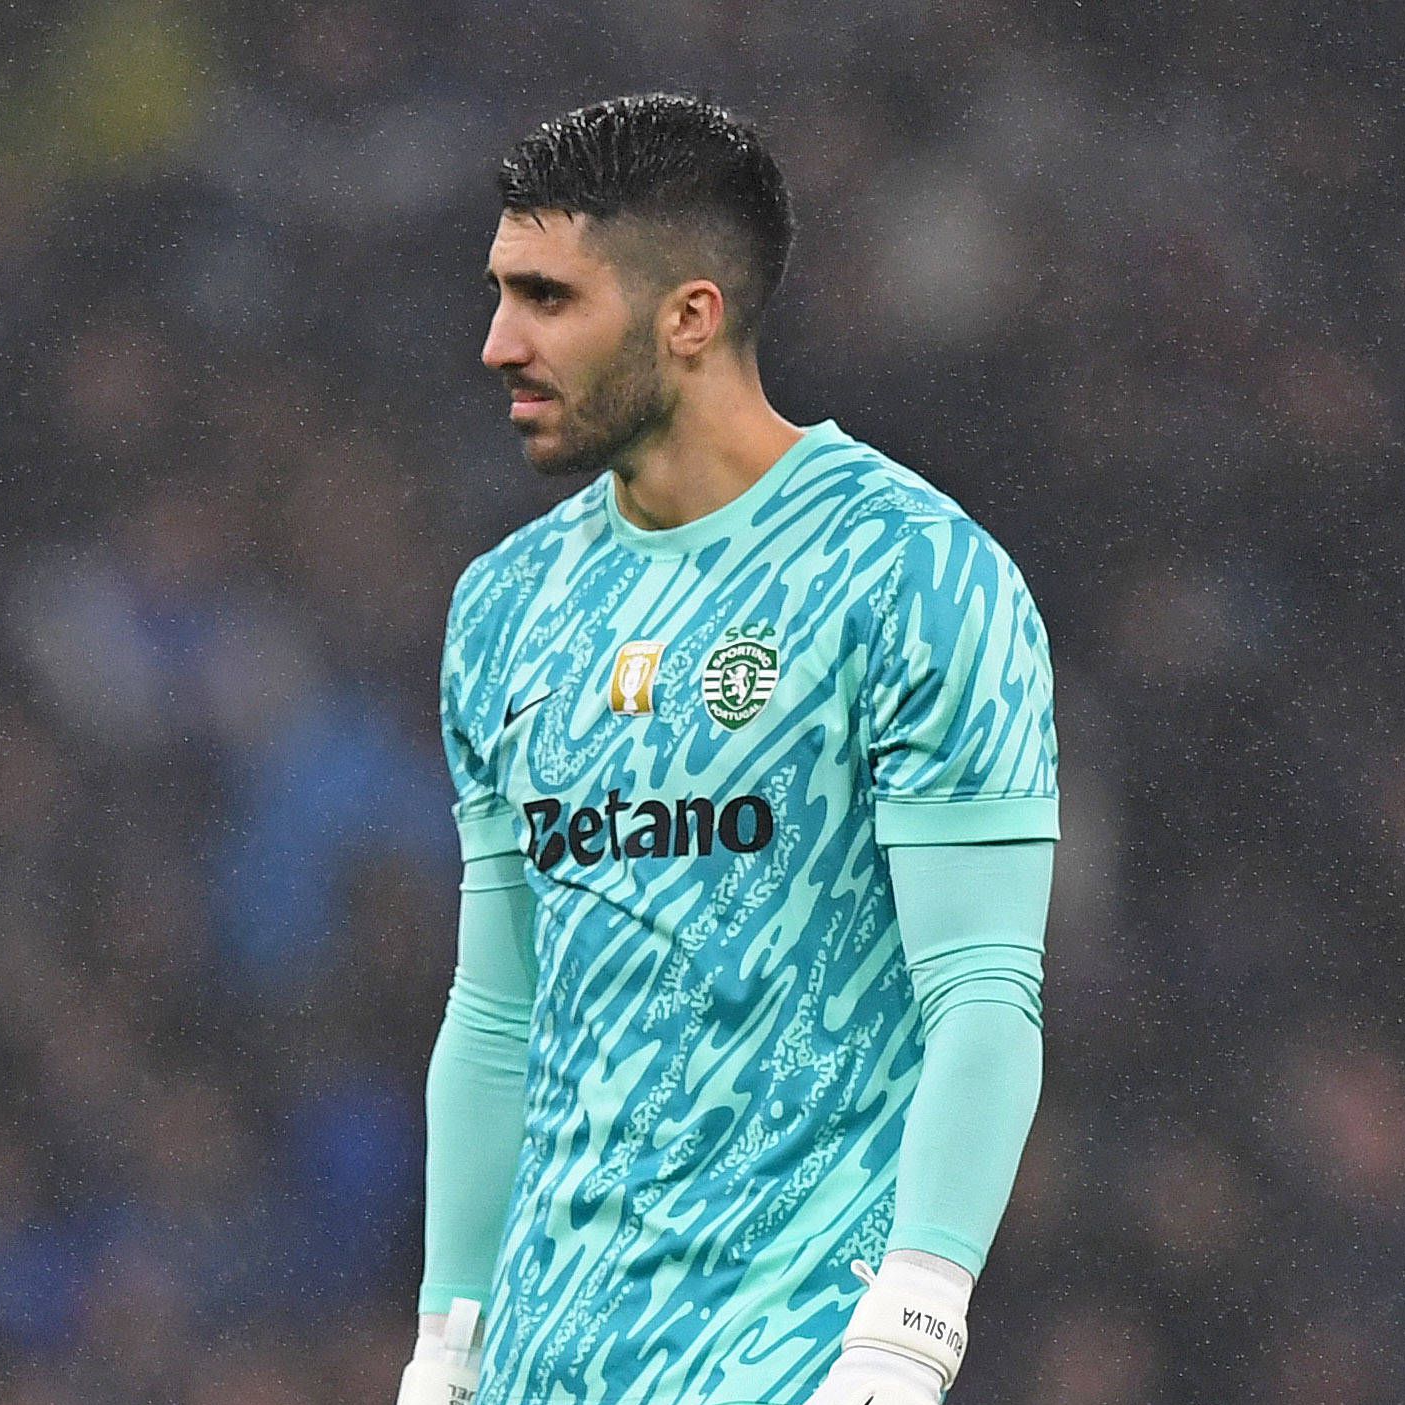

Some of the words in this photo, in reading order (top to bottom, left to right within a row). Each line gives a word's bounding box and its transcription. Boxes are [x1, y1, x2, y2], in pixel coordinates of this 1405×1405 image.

[724, 623, 776, 643] SCP
[711, 646, 772, 669] SPORTING
[710, 703, 761, 721] PORTUGAL
[523, 789, 774, 873] Betano
[903, 1307, 947, 1340] SILVA
